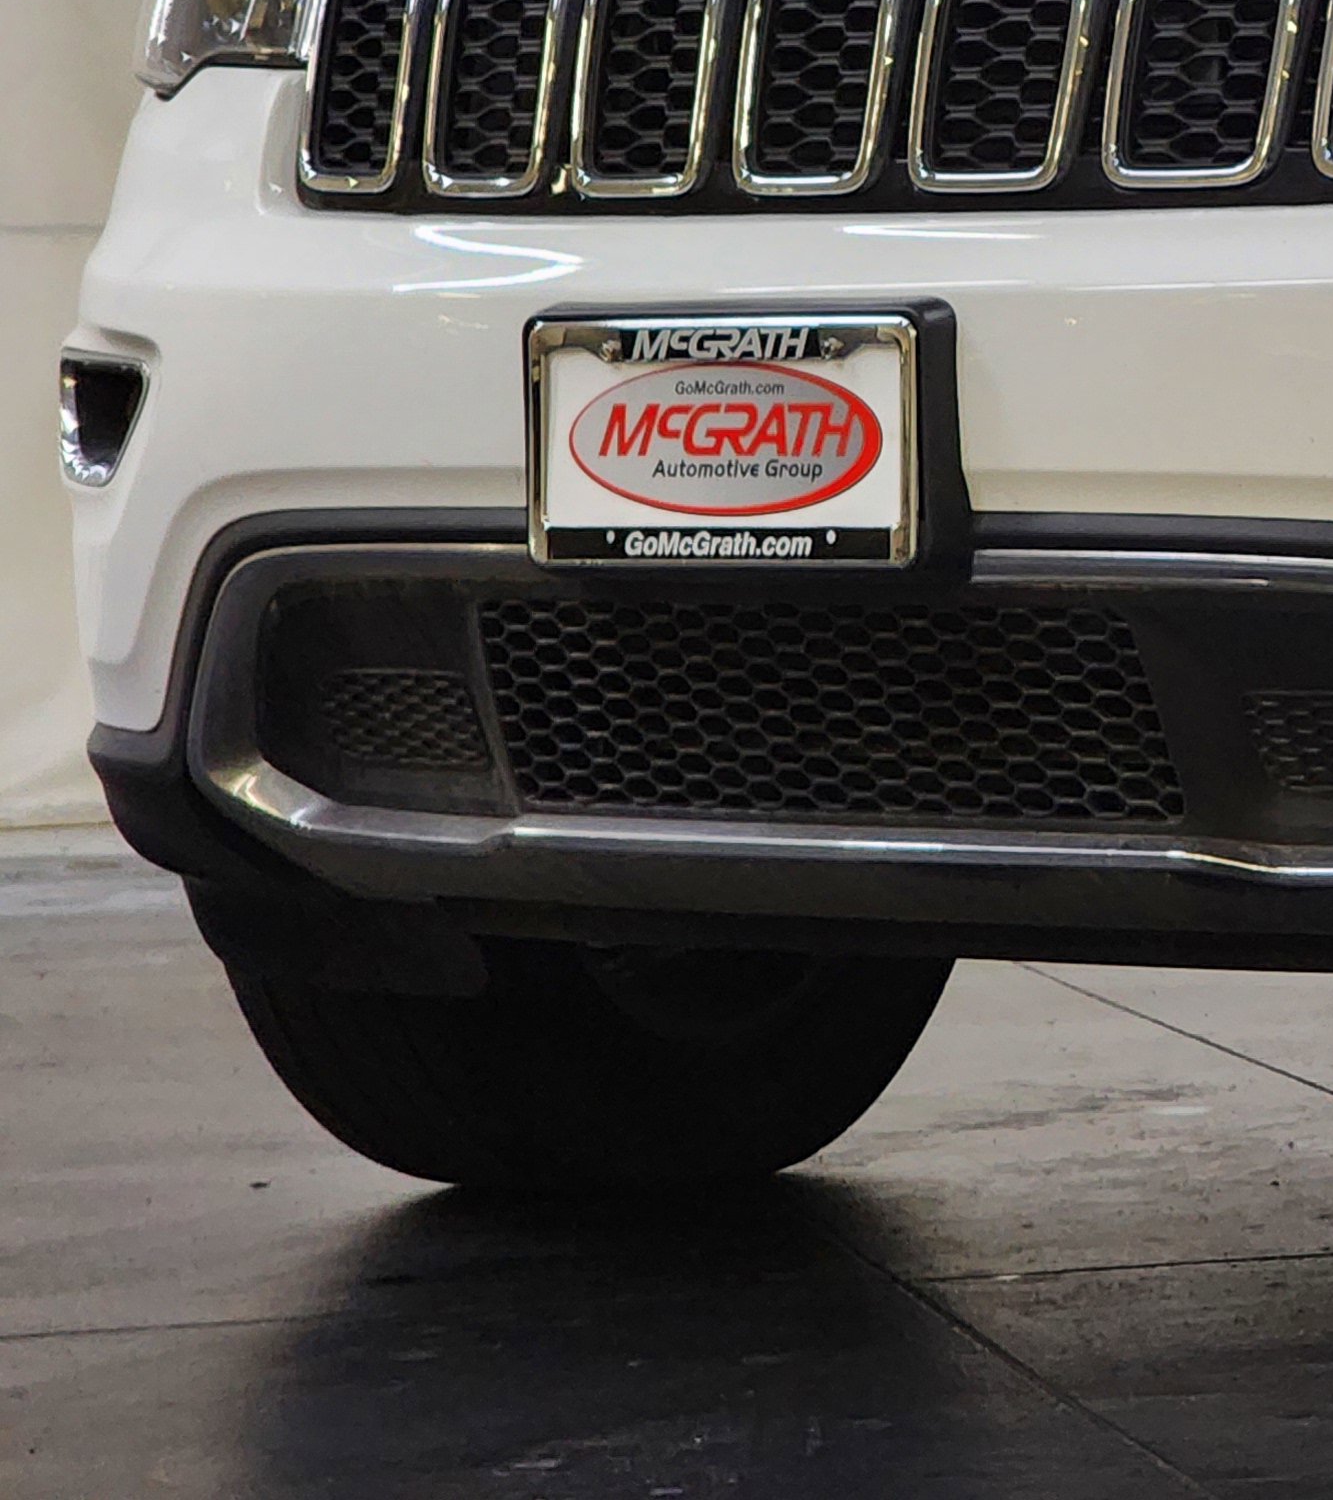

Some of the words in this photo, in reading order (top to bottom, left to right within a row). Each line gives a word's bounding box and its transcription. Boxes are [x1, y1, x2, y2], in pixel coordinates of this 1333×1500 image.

[675, 380, 785, 396] GoMcGrath.com
[652, 459, 759, 479] Automotive
[765, 459, 824, 484] Group
[624, 530, 813, 558] GoMcGrath.com
